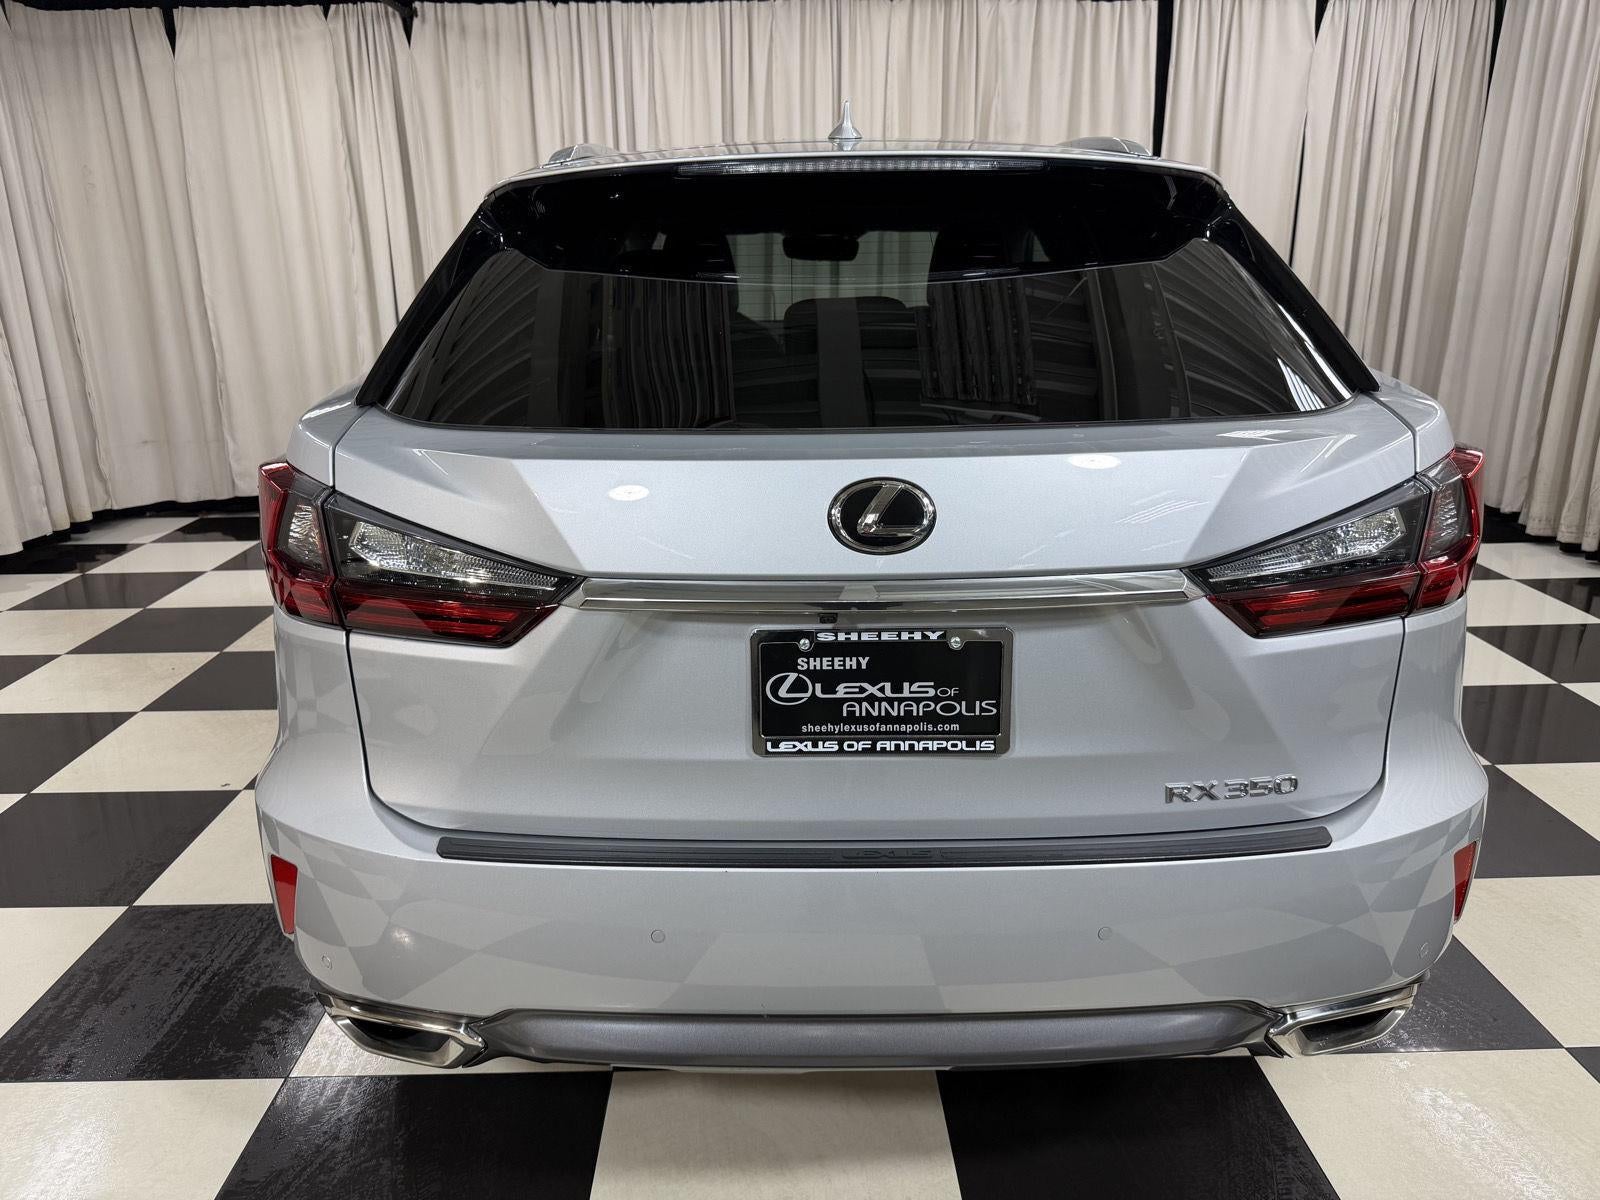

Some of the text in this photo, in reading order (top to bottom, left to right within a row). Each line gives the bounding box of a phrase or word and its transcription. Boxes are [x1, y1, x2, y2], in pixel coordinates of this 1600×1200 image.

[817, 631, 945, 641] SHEEHY
[797, 657, 870, 670] SHEEHY
[815, 682, 960, 698] LEXUS OF
[842, 700, 997, 717] ANNAPOLIS
[801, 722, 960, 733] sheehylexusofannapolis.com
[766, 740, 995, 752] LEXUS OF ANNAPOLIS
[1165, 774, 1298, 803] RX 350
